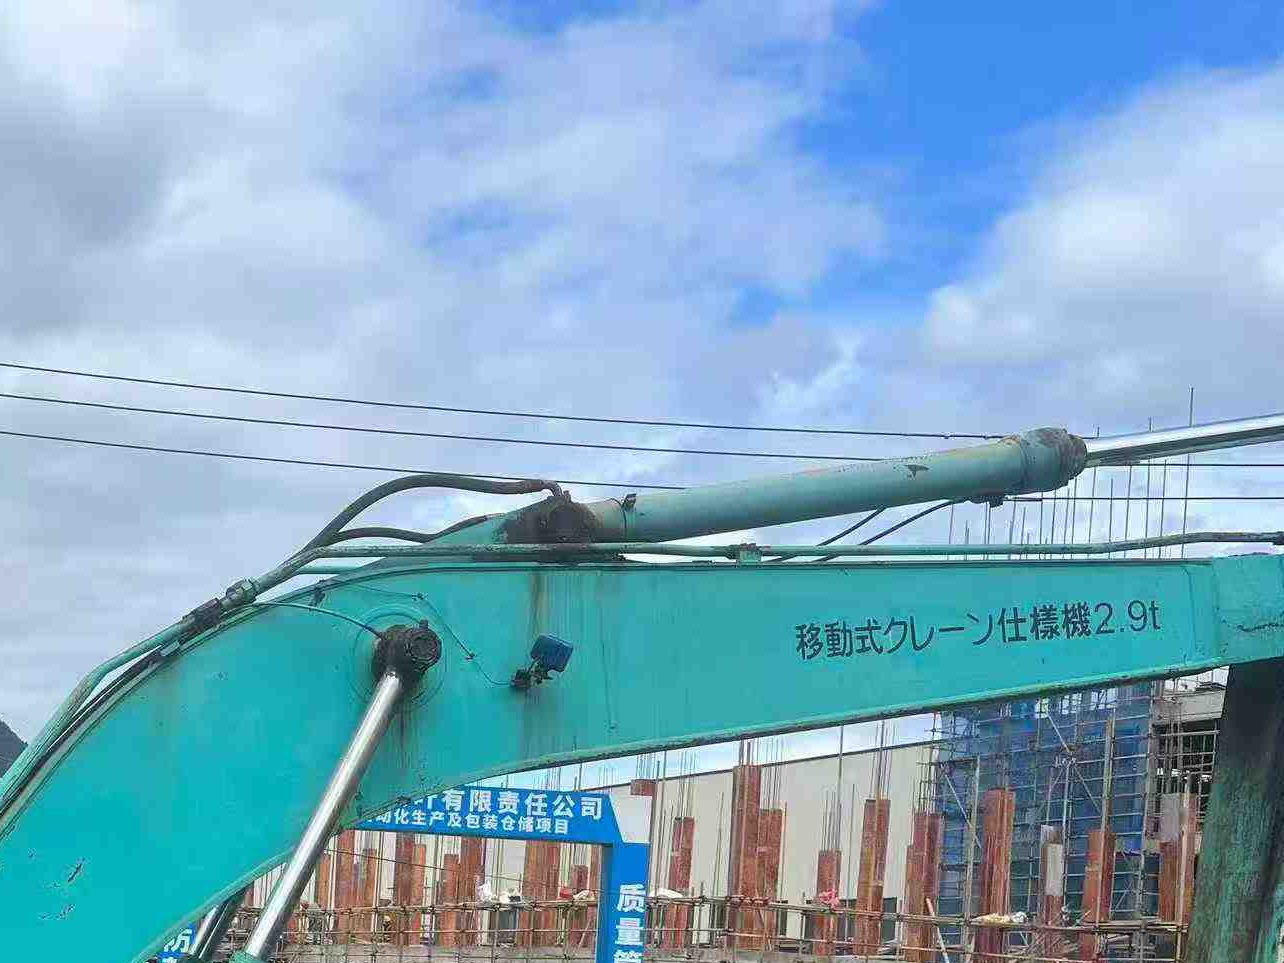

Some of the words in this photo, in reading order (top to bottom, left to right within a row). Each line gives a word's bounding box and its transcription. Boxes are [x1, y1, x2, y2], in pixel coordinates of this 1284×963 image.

[414, 788, 603, 820] 有限责任公司
[368, 807, 569, 834] 动化生产及包装仓储项目
